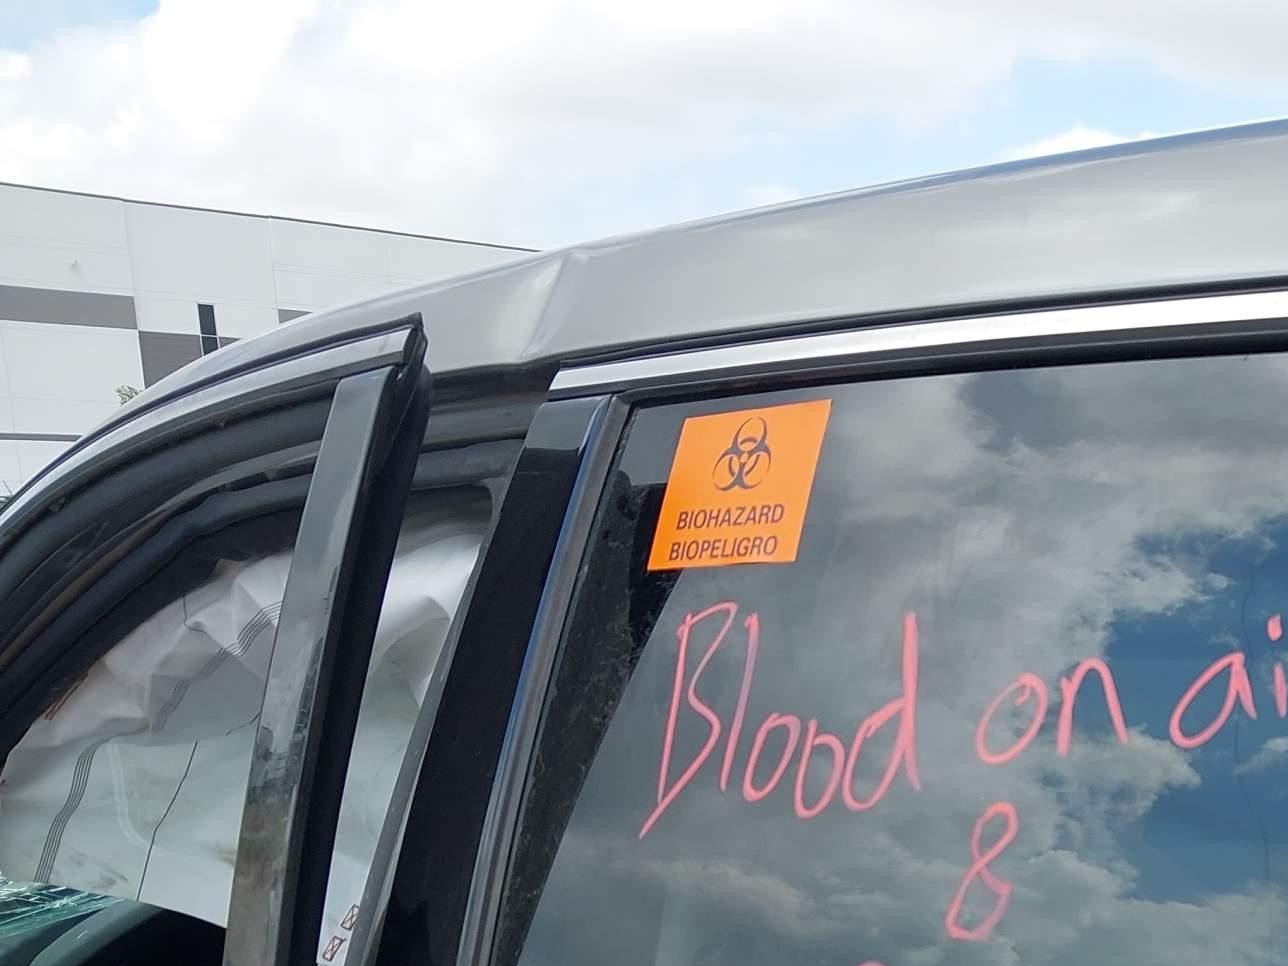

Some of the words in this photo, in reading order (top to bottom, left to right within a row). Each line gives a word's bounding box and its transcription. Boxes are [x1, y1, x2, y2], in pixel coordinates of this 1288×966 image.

[676, 503, 785, 531] BIOHAZARD
[668, 535, 778, 562] BIOPELIGRO
[638, 600, 922, 839] Blood
[975, 656, 1128, 766] on
